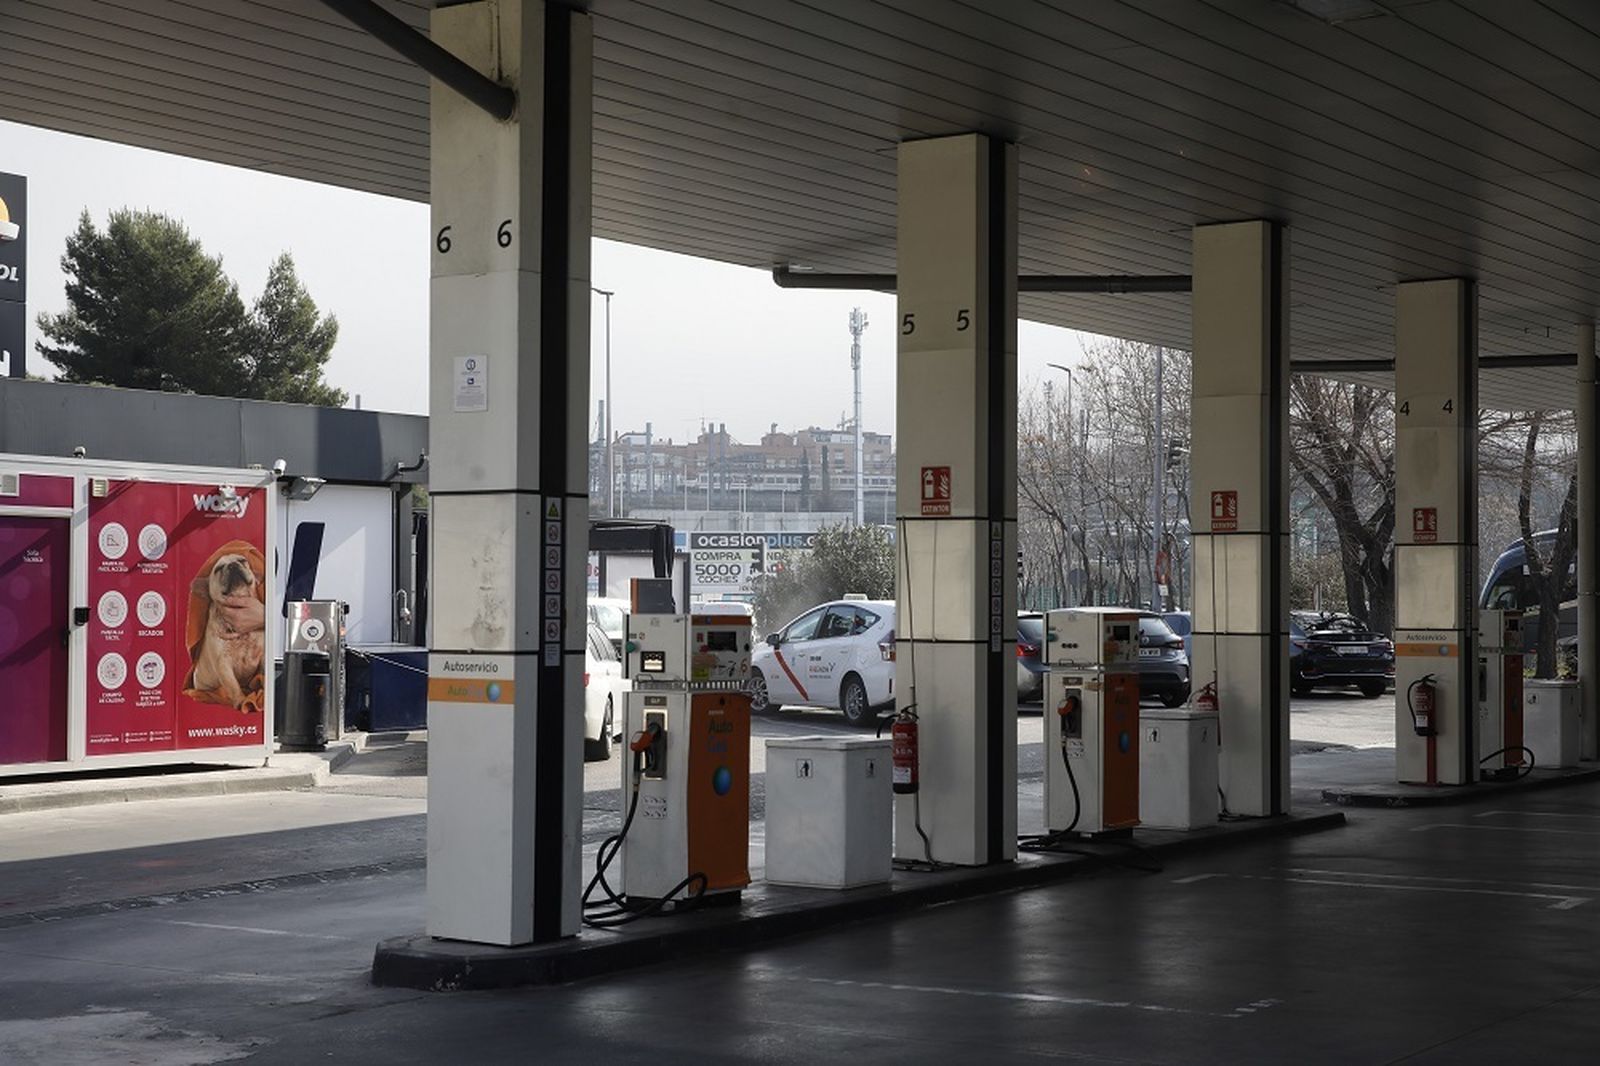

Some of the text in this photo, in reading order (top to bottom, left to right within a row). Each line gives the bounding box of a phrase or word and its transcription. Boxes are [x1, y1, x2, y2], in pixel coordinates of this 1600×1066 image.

[436, 225, 451, 254] 6
[497, 219, 512, 248] 6
[902, 313, 915, 335] 5
[957, 309, 970, 331] 5
[1400, 401, 1410, 416] 4
[1442, 399, 1453, 414] 4
[694, 551, 742, 561] COMPRA
[695, 564, 741, 576] 5000
[698, 576, 738, 584] COCHES
[443, 660, 499, 673] Autoservicio
[188, 724, 257, 738] www.wasky.es
